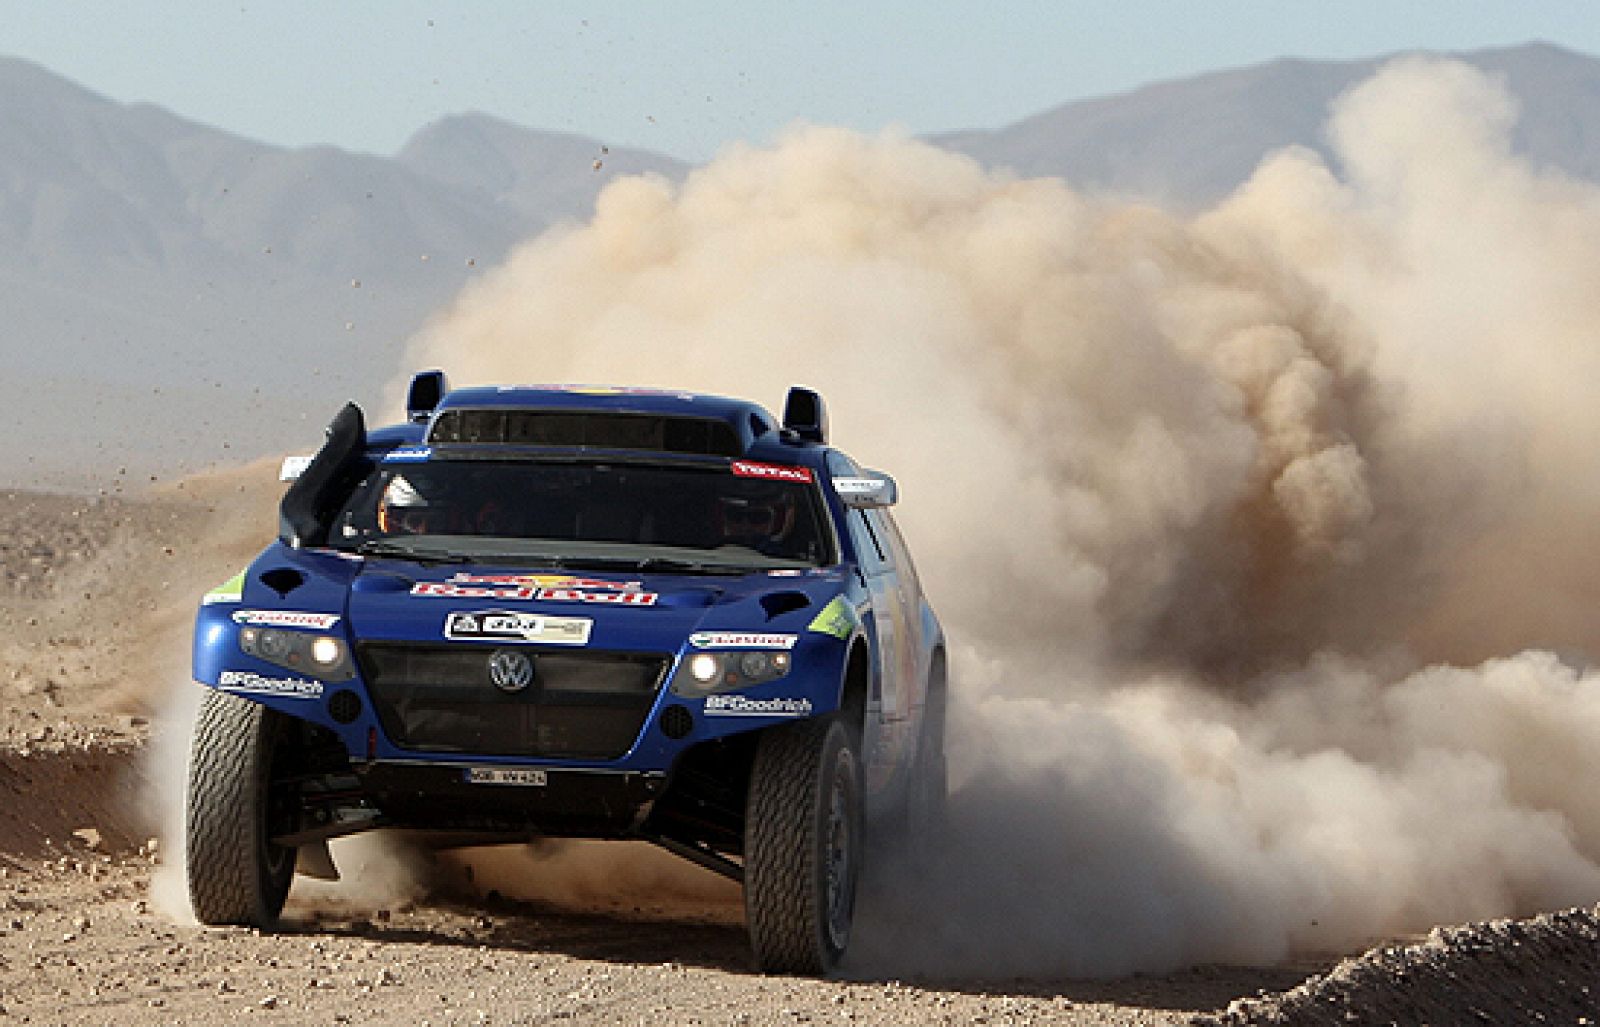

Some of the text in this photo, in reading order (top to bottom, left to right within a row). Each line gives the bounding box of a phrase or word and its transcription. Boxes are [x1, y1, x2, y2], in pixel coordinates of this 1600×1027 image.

[735, 462, 810, 481] TOTAL
[410, 581, 658, 606] Red Bull
[220, 671, 324, 695] BFGoodrich
[705, 694, 812, 712] BFGoodrich
